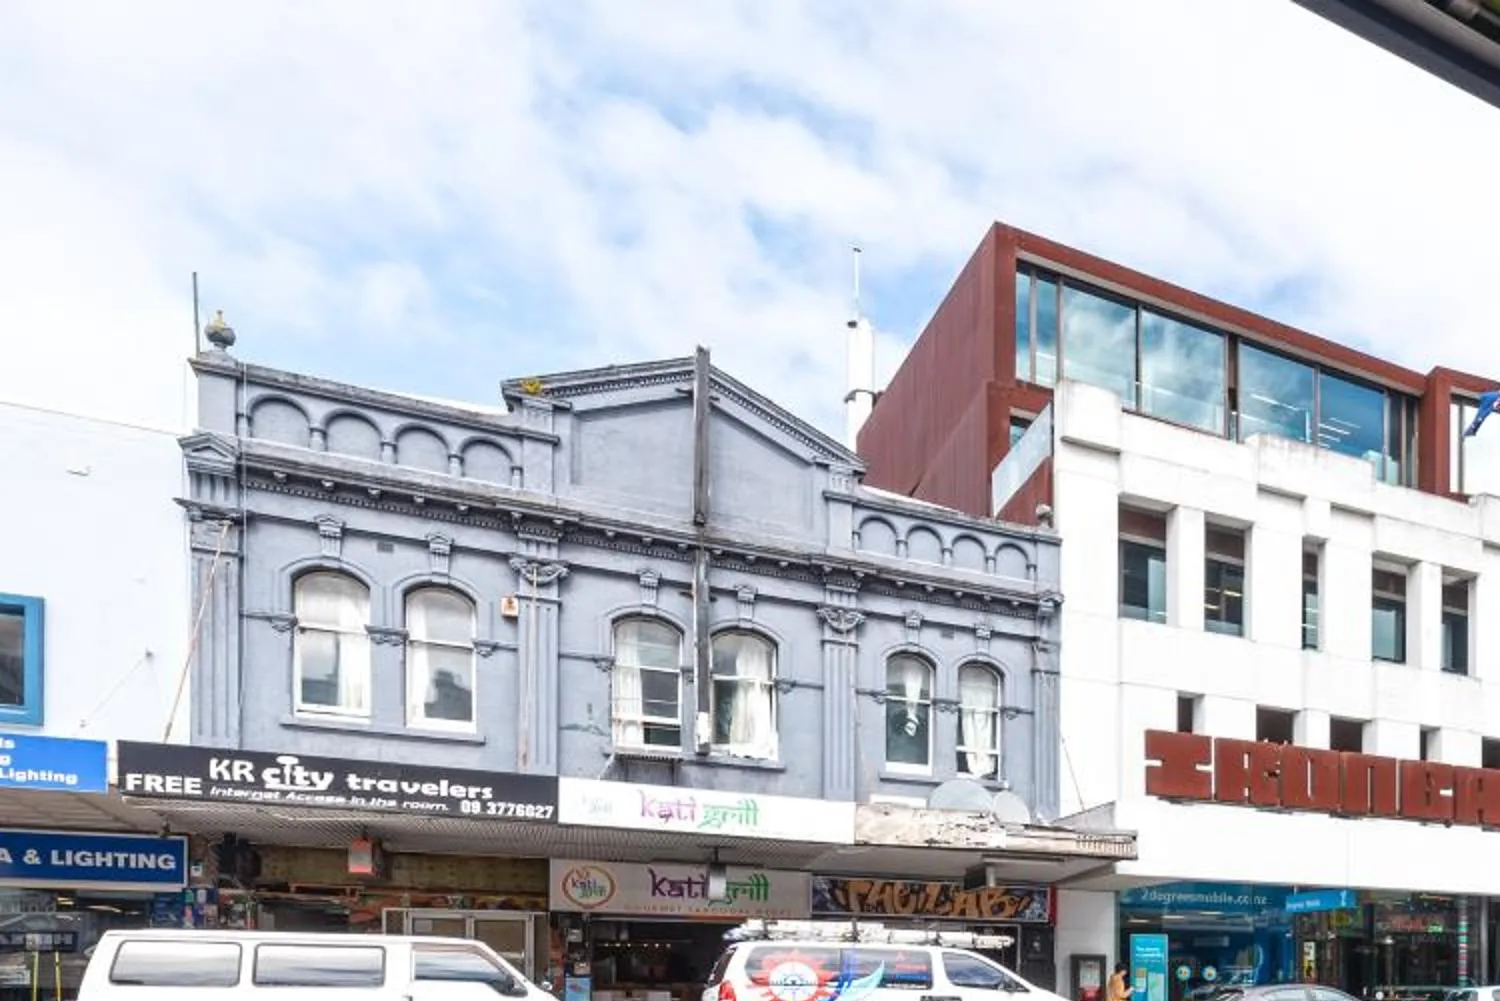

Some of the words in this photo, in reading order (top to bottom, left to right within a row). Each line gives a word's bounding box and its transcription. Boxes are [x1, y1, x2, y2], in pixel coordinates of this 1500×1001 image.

[125, 772, 203, 795] FREE
[208, 757, 255, 783] KR
[261, 755, 335, 791] city
[345, 773, 493, 800] travelers
[638, 789, 697, 823] kati
[23, 849, 42, 865] &
[51, 849, 177, 869] LIGHTING
[647, 867, 710, 899] kati
